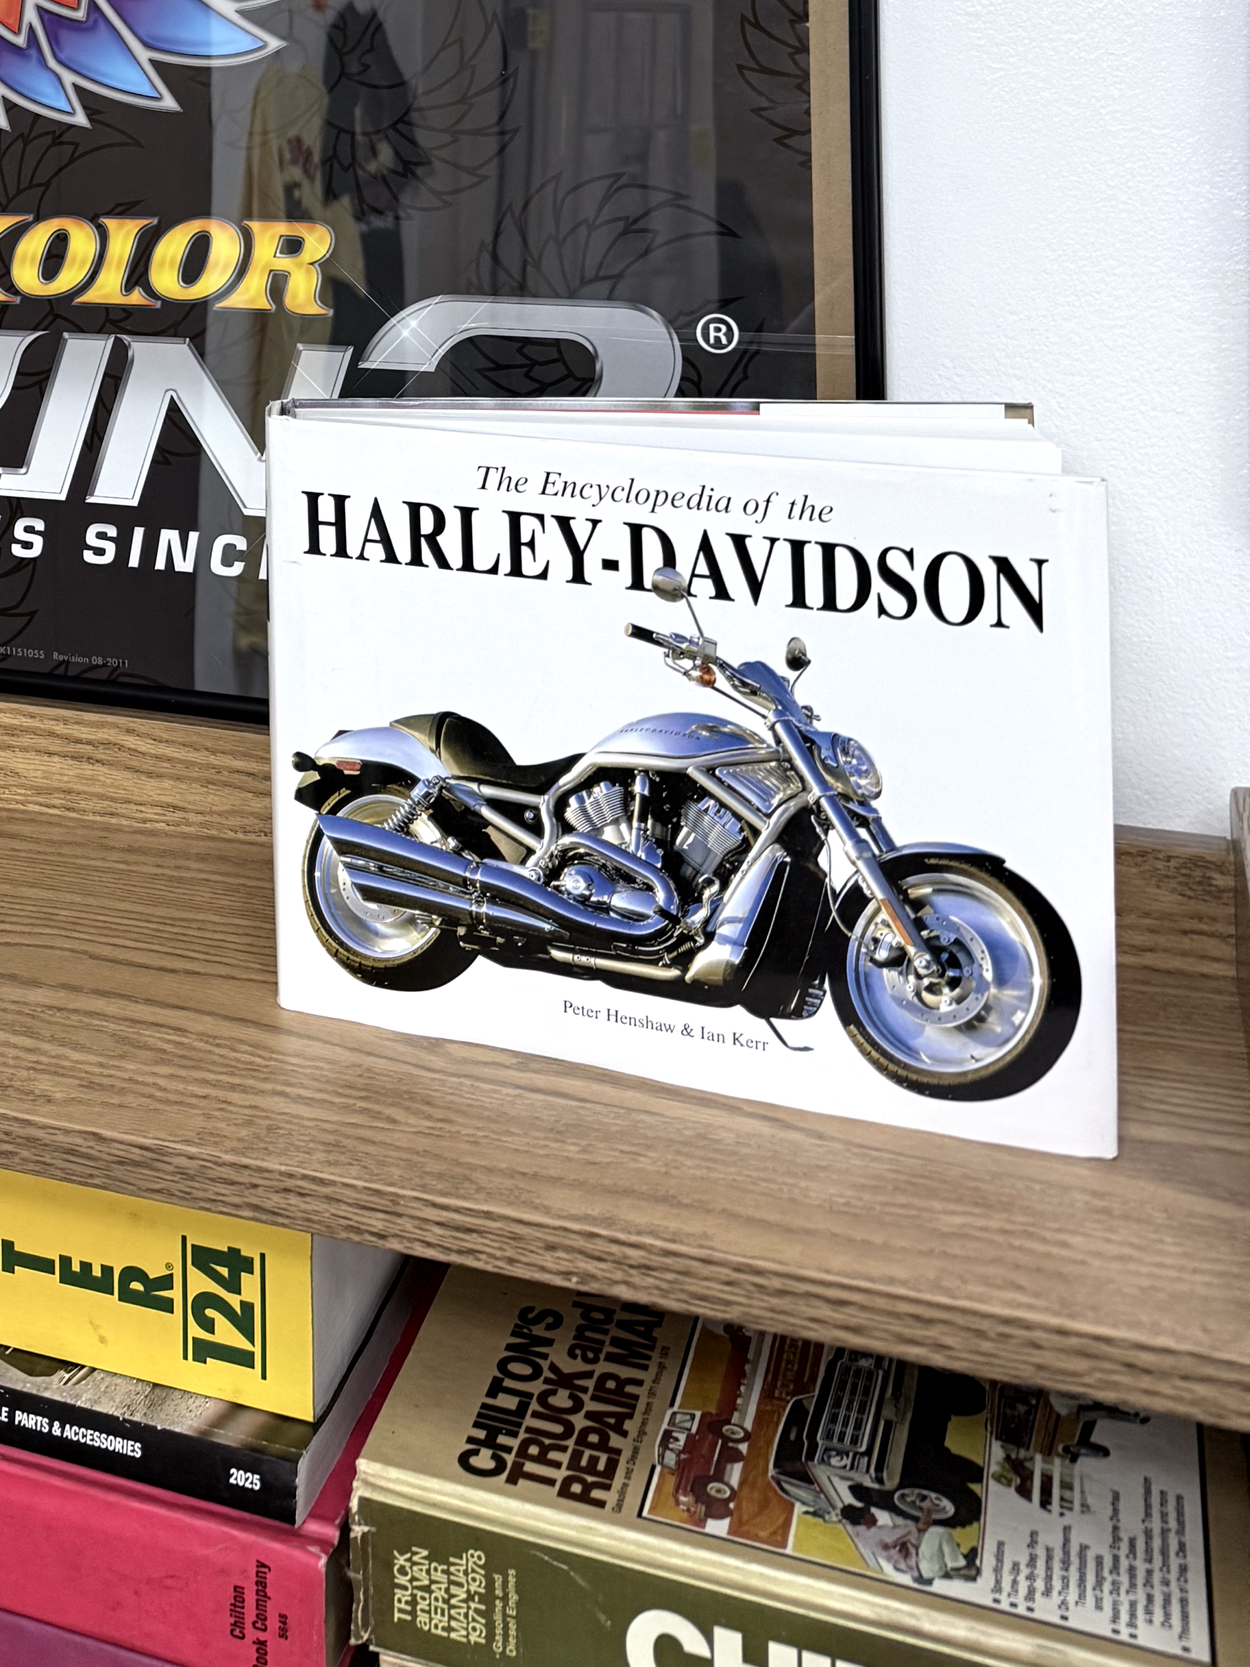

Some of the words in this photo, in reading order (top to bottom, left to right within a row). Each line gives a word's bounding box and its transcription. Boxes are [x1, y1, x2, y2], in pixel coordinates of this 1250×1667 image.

[476, 465, 528, 495] The
[538, 470, 732, 515] Encyclopedia
[743, 491, 778, 524] of
[787, 494, 834, 523] the
[83, 523, 268, 581] SINC
[301, 491, 1049, 634] HARLEY-DAVIDSON
[53, 652, 89, 664] Revision
[91, 656, 129, 668] 08-2011
[563, 1000, 601, 1020] Peter
[606, 1008, 676, 1034] Henshaw
[681, 1023, 695, 1038] &
[700, 1026, 726, 1044] Ian
[732, 1032, 769, 1051] Kerr
[191, 1244, 255, 1370] 124
[457, 1306, 564, 1478] CHILTON'S
[504, 1360, 596, 1488] TRUCK
[567, 1300, 616, 1365] and
[15, 1410, 49, 1433] PARTS
[52, 1420, 61, 1436] &
[63, 1423, 142, 1458] ACCESSORIES
[556, 1371, 645, 1509] REPAIR
[229, 1468, 261, 1490] 2025
[394, 1549, 412, 1623] TRUCK
[411, 1546, 429, 1586] VAN
[493, 1573, 503, 1597] and
[506, 1569, 519, 1617] Engines
[229, 1585, 246, 1640] Chilton
[252, 1559, 272, 1632] Company
[413, 1590, 430, 1631] and
[430, 1562, 448, 1637] REPAIR
[449, 1552, 467, 1643] MANUAL
[467, 1549, 486, 1645] 1971-1978
[252, 1637, 269, 1667] ook
[506, 1617, 517, 1657] Diesel
